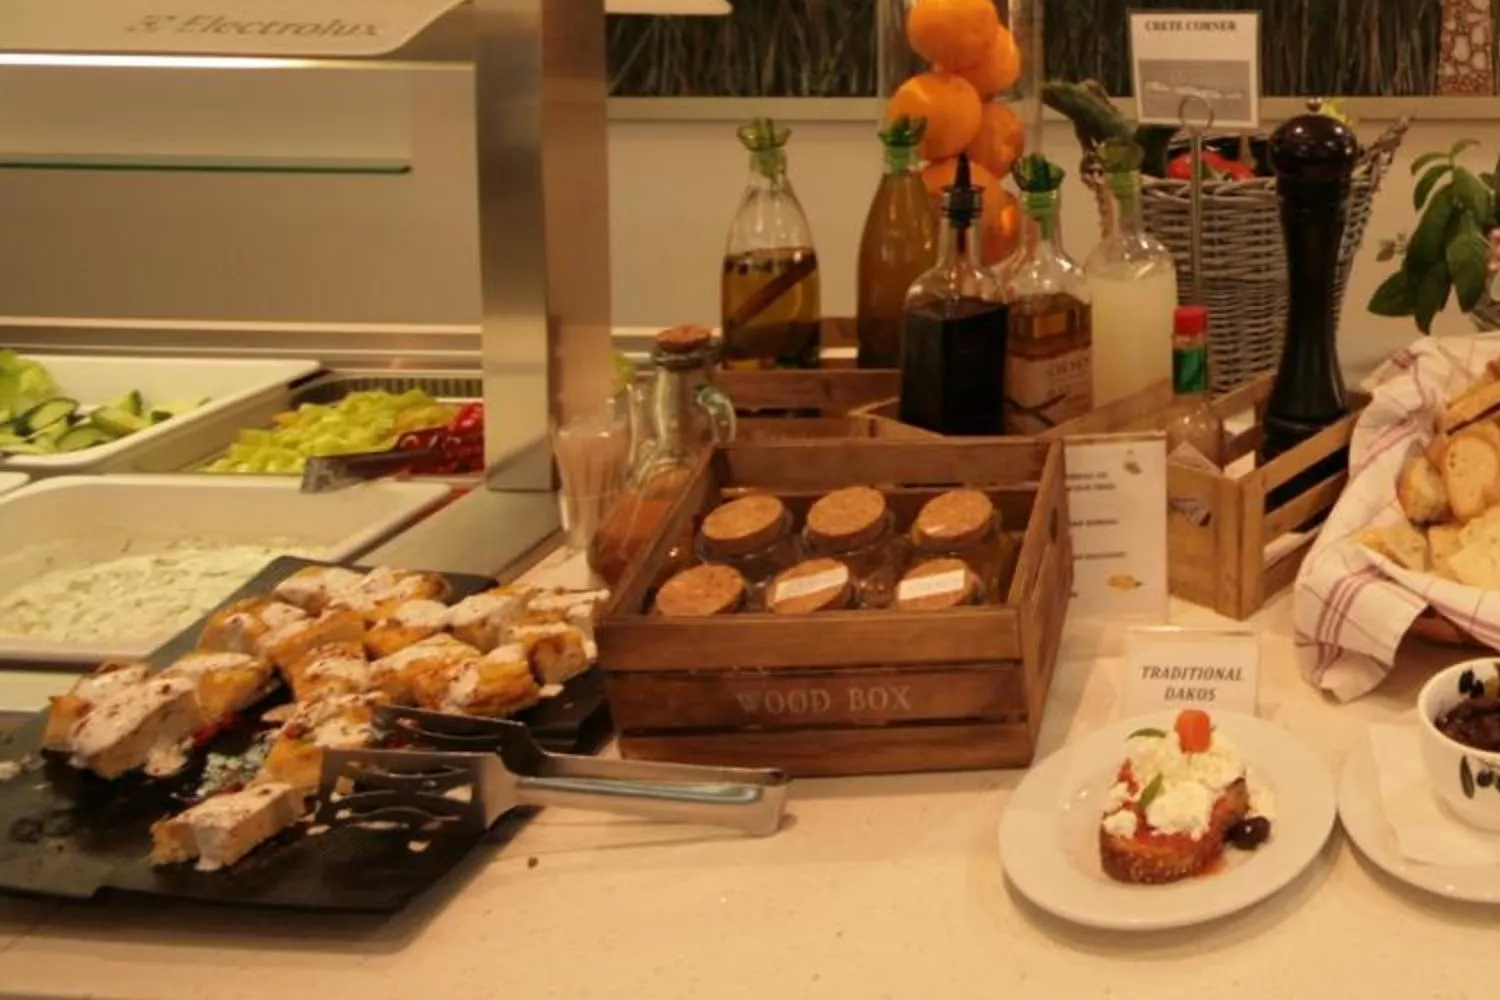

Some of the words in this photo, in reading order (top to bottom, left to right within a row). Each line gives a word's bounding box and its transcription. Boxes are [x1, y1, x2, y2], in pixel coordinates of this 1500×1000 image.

[177, 14, 377, 37] Electrolux
[1186, 20, 1237, 31] CORNER
[1139, 665, 1245, 682] TRADITIONAL
[735, 688, 832, 715] WOOD
[847, 685, 913, 711] BOX
[1163, 685, 1217, 703] DAKOS
